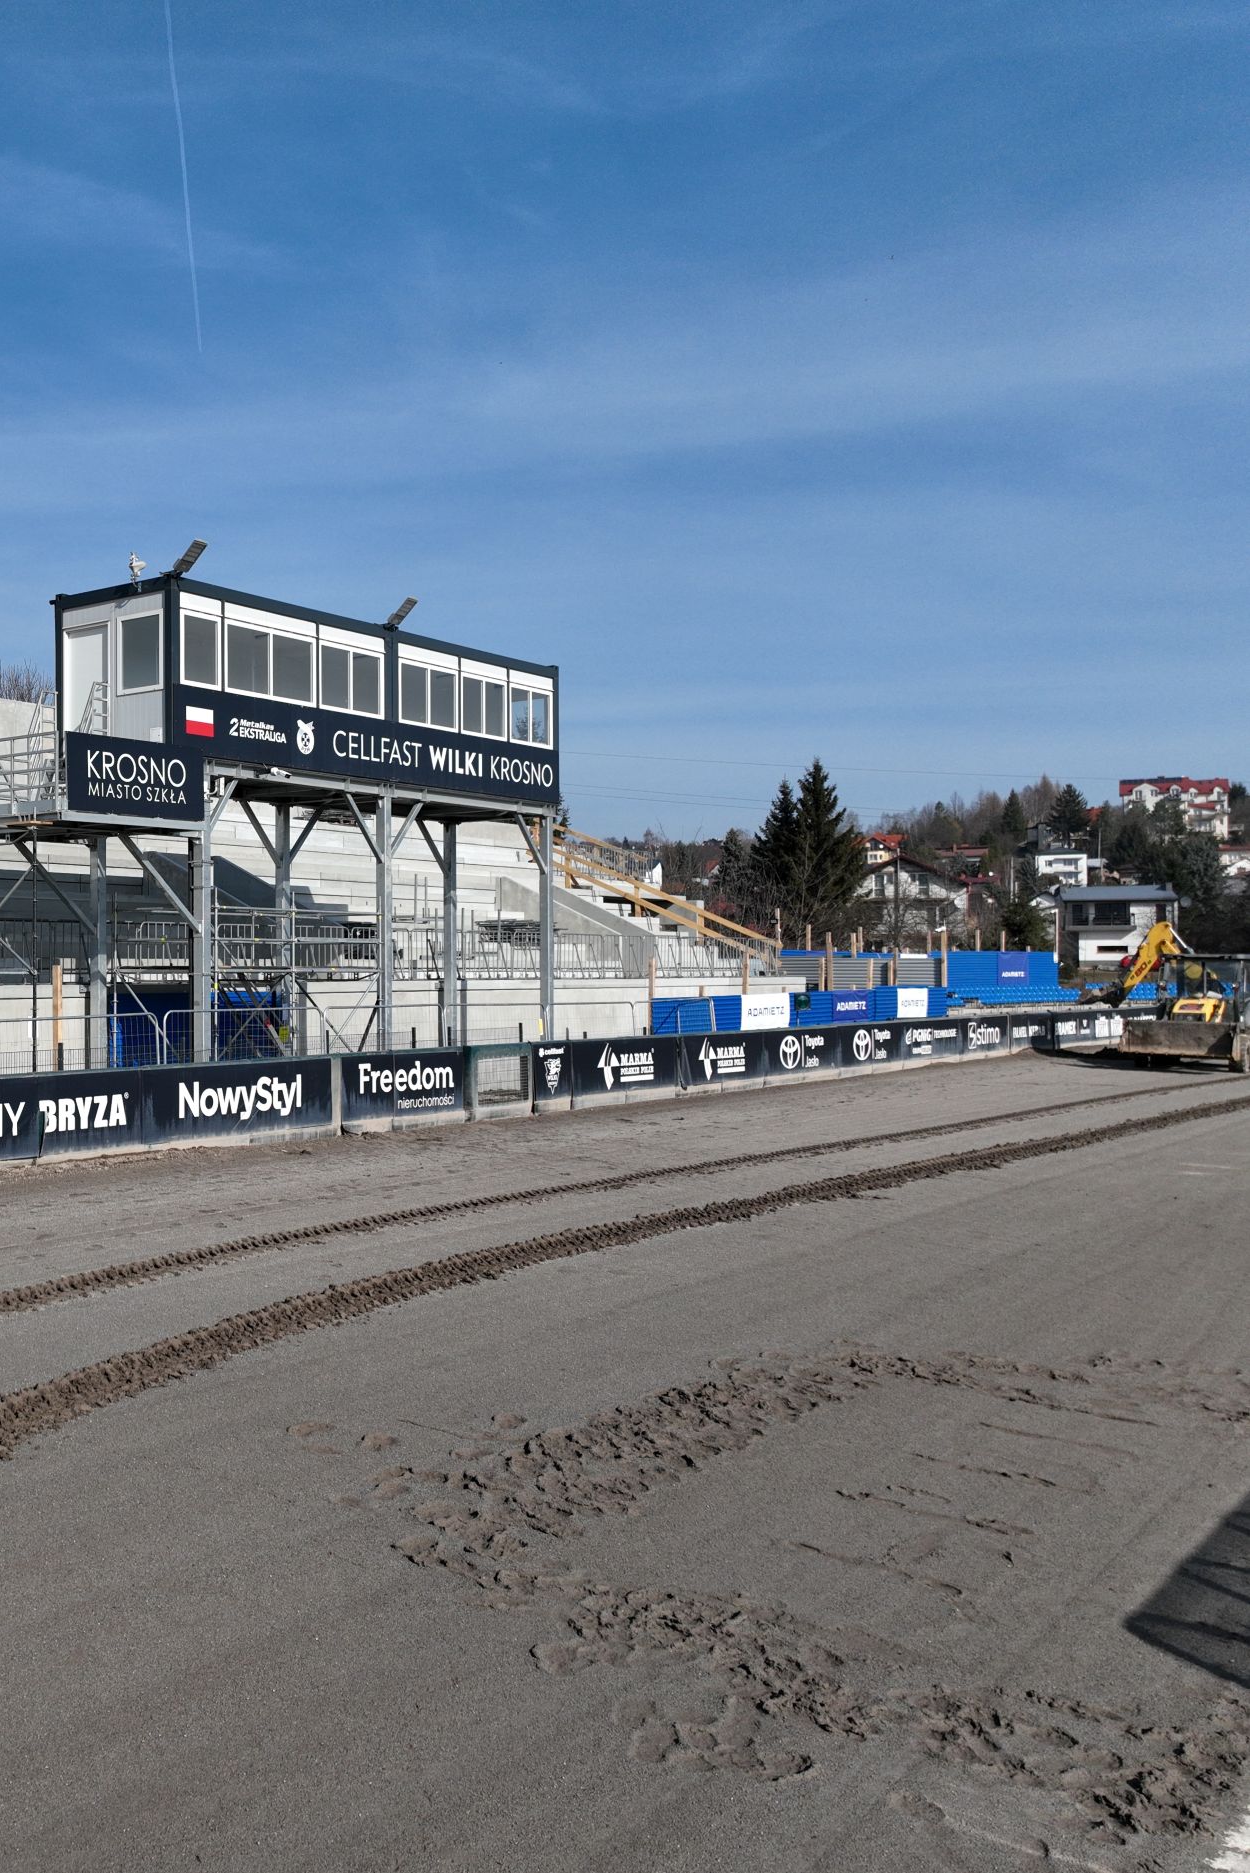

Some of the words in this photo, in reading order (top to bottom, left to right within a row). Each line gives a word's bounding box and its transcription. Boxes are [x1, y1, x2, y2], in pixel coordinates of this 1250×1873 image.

[229, 718, 239, 737] 2
[239, 719, 275, 731] Metalkas
[239, 727, 287, 744] EKSTRALIGA
[332, 730, 422, 768] CELLFAST
[428, 745, 483, 777] WILKI
[490, 755, 554, 788] KROSNO
[87, 749, 187, 788] KROSNO
[88, 781, 142, 801] MIASTO
[146, 786, 187, 805] SZKŁA
[747, 1006, 785, 1018] ADAMIETZ
[836, 1000, 867, 1012] ADAMIETZ
[805, 1034, 825, 1050] Toyota
[874, 1029, 892, 1043] Toyota
[976, 1023, 1000, 1045] stimo
[619, 1051, 654, 1067] MARMA
[716, 1046, 746, 1059] MARMA
[358, 1060, 455, 1095] Freedom
[178, 1073, 302, 1120] NowyStyl
[397, 1094, 455, 1110] nieruchomości
[39, 1093, 127, 1134] BRYZA
